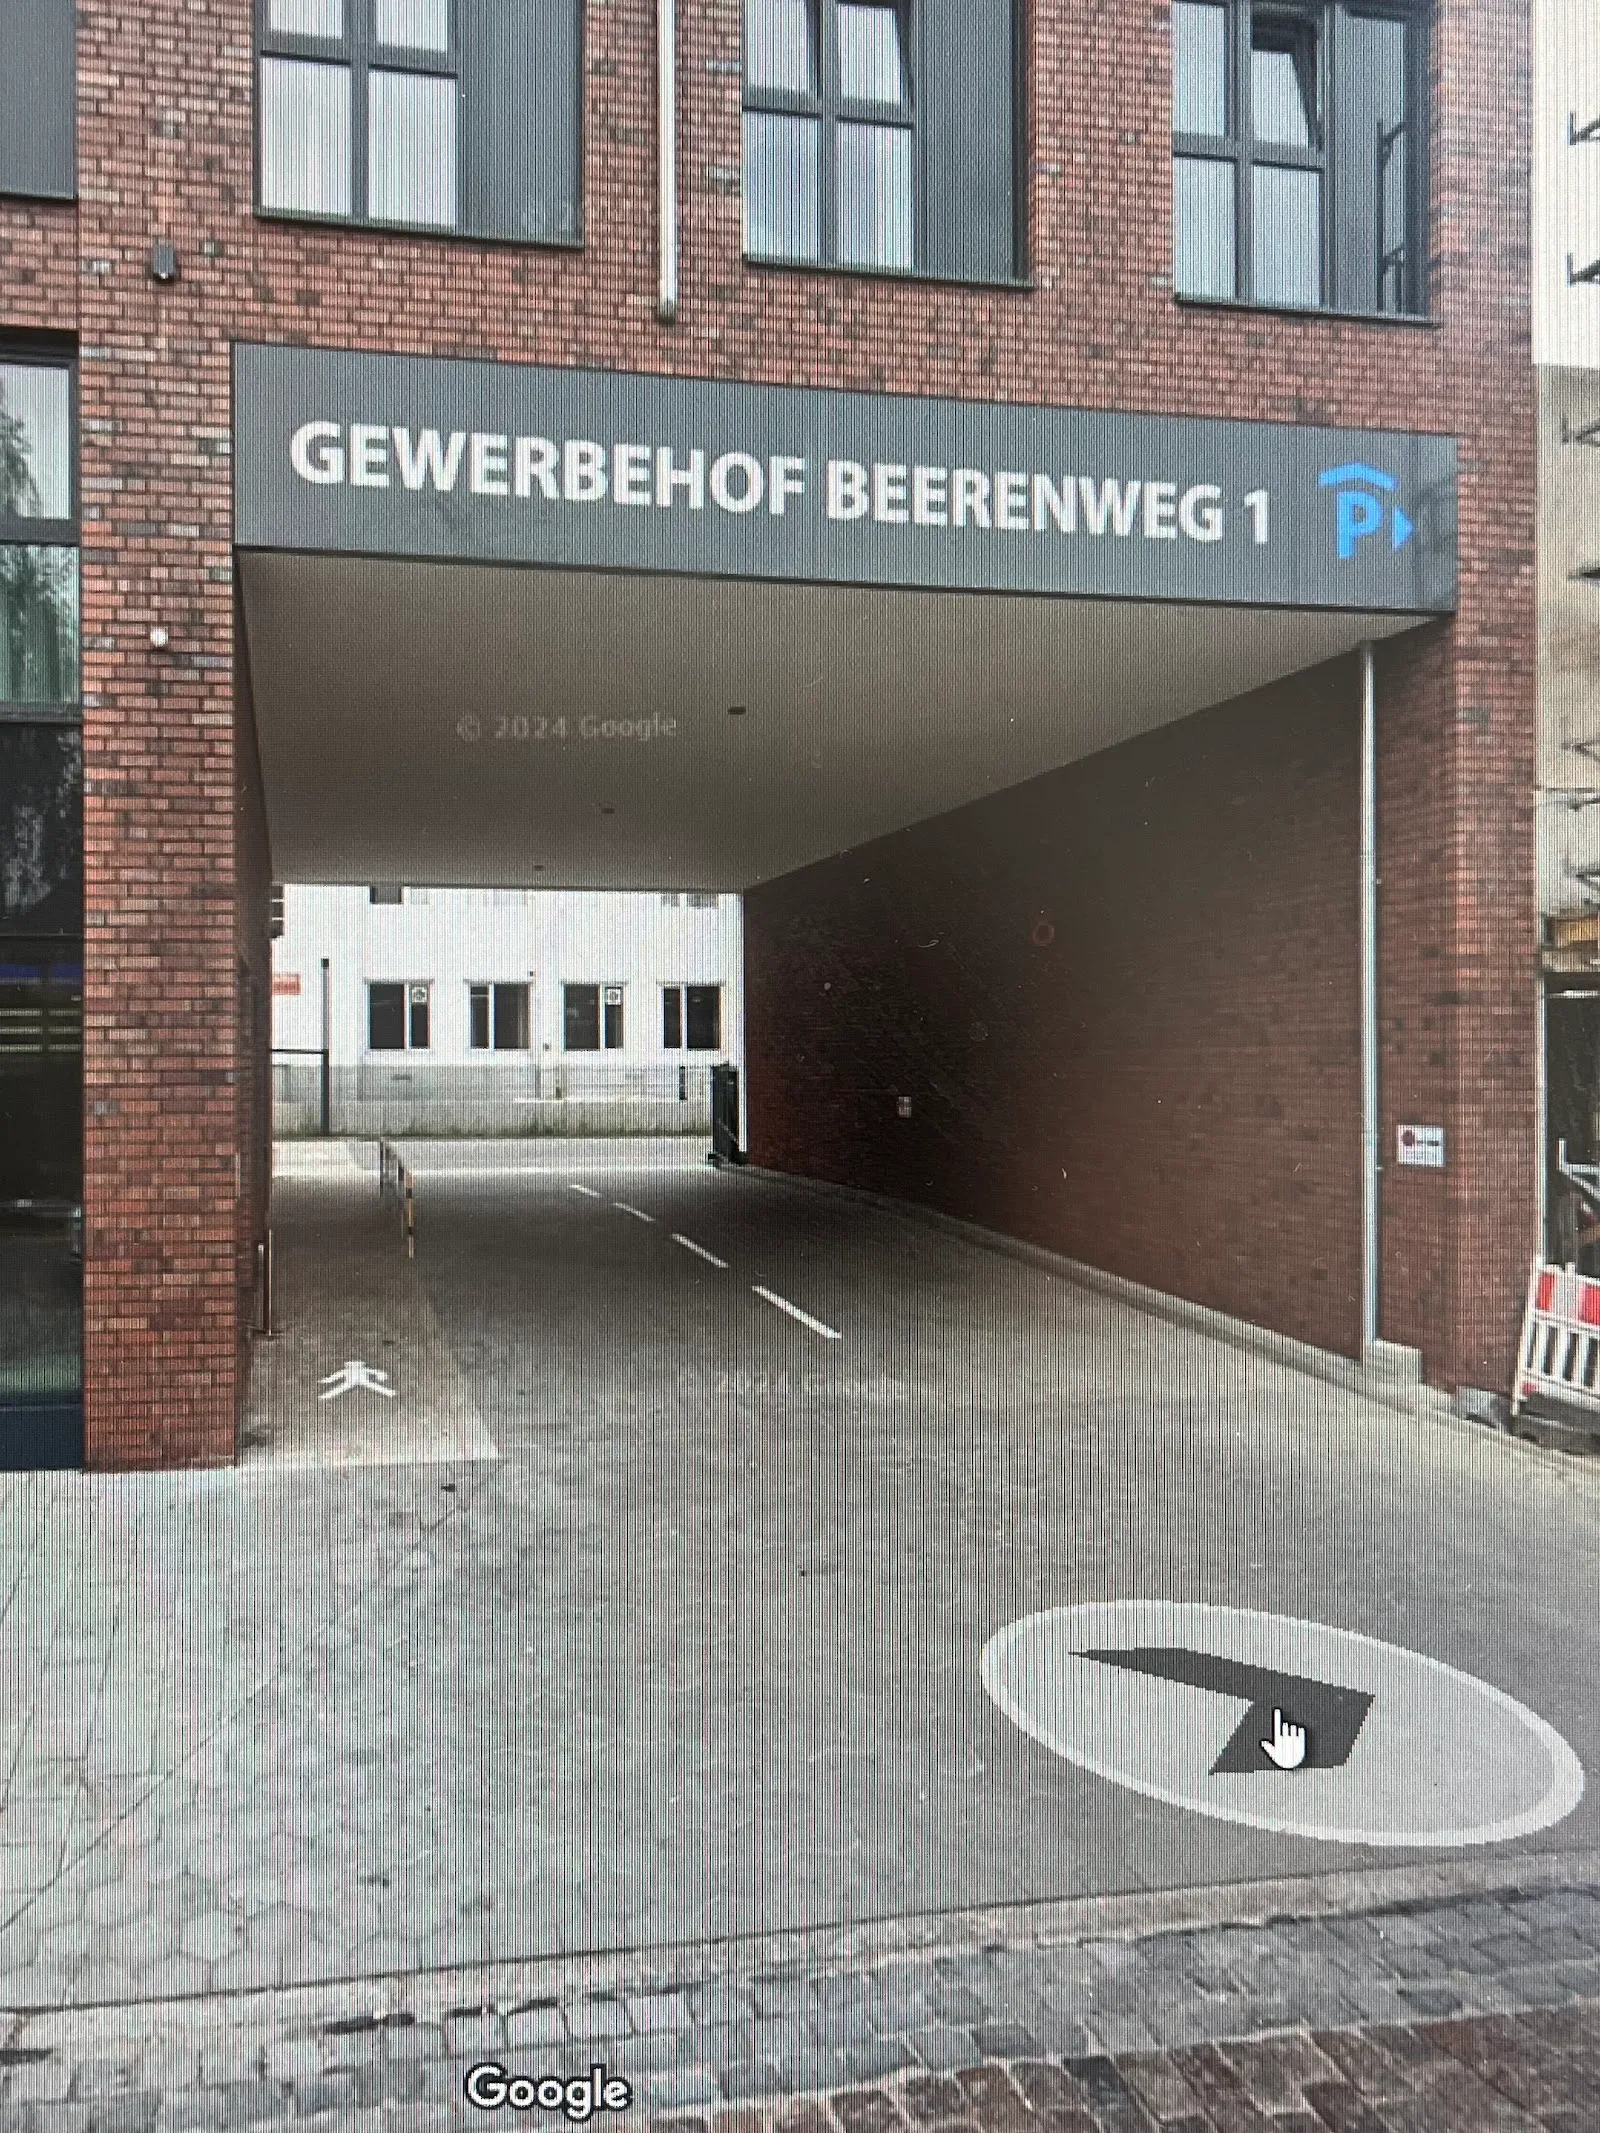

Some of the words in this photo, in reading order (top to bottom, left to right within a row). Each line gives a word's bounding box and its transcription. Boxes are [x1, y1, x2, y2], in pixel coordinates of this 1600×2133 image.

[290, 420, 806, 515] GEWERBEHOF
[826, 458, 1223, 544] BEERENWEG
[1243, 489, 1268, 545] 1
[1337, 491, 1383, 559] P
